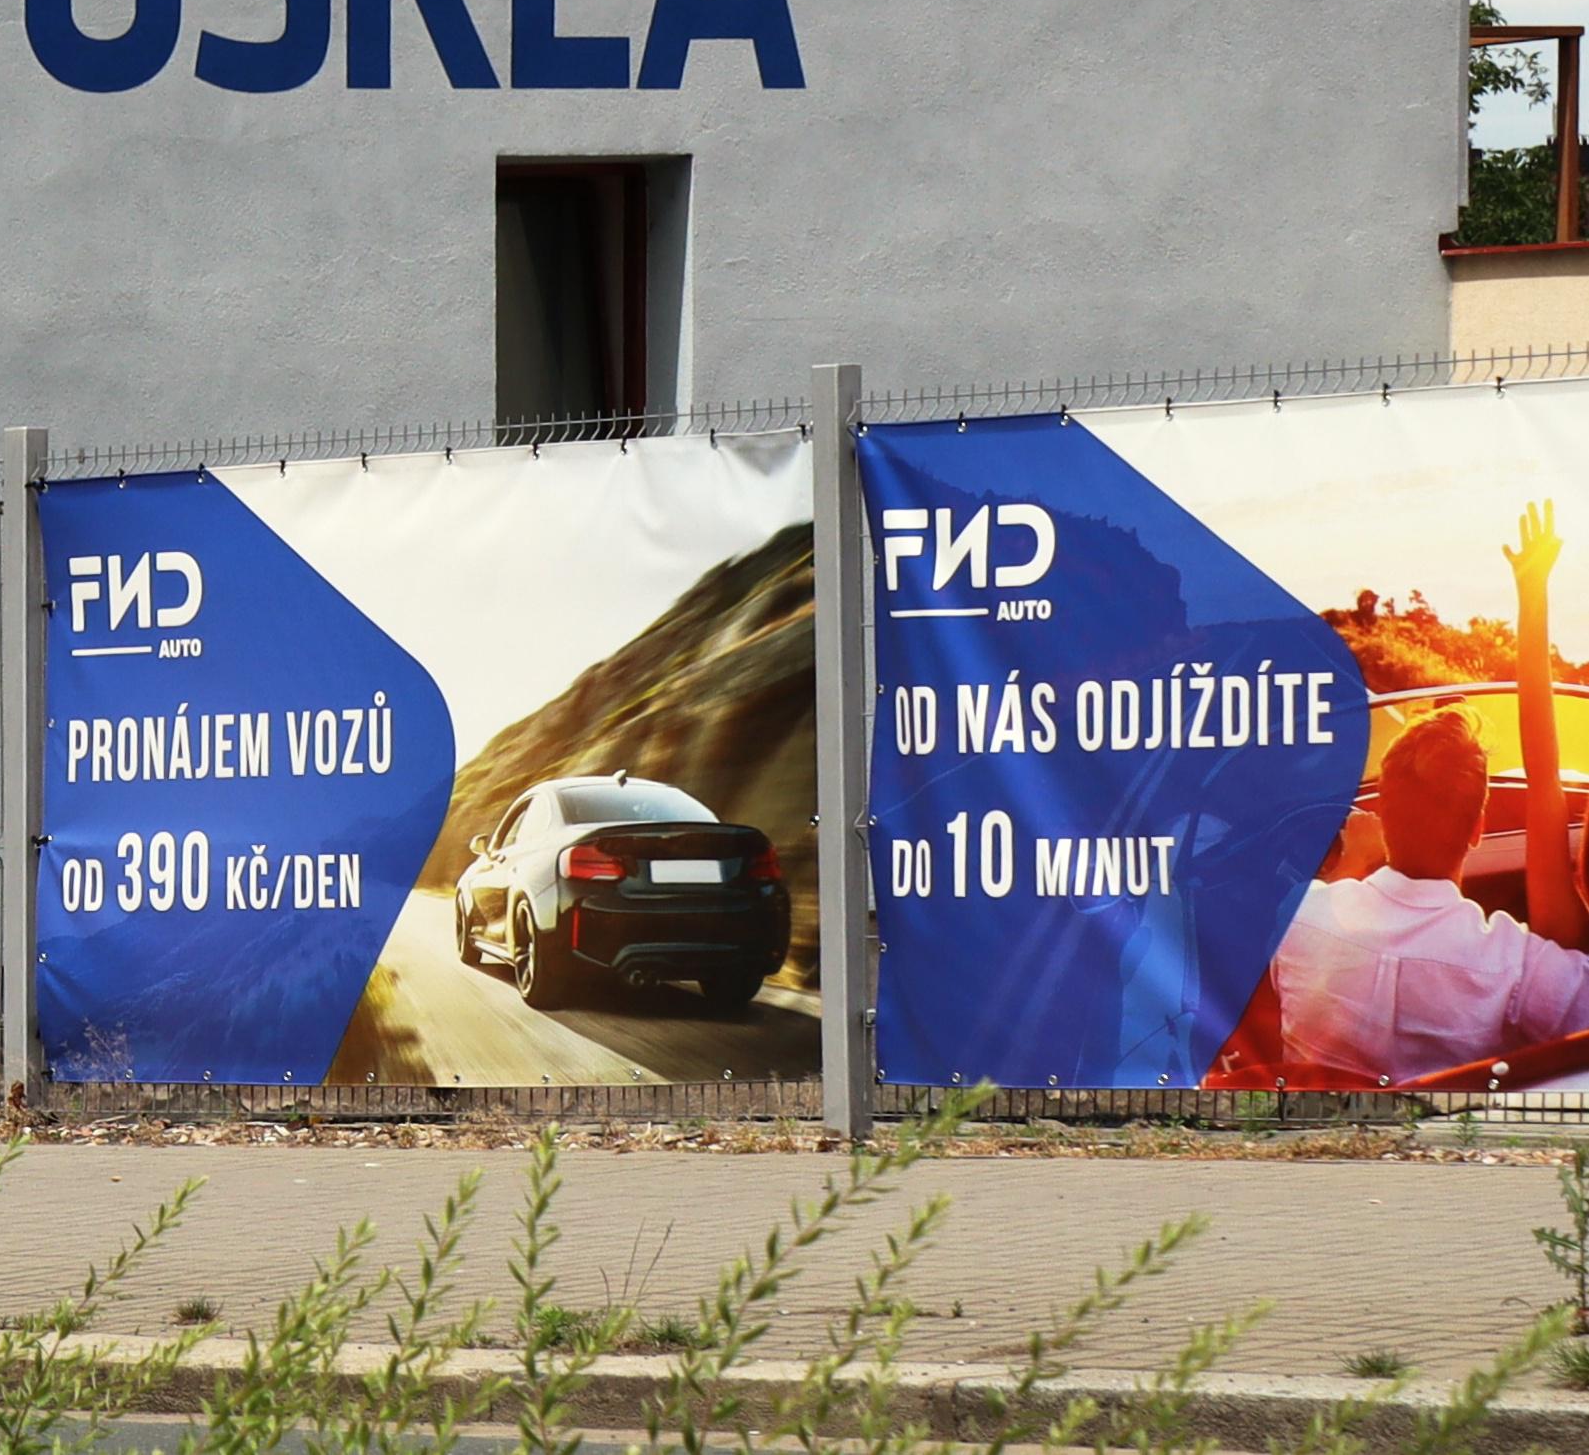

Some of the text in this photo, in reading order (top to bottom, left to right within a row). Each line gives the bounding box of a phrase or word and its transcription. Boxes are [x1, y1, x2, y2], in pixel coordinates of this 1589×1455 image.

[158, 638, 202, 658] AUTO
[996, 599, 1052, 621] AUTO
[68, 690, 392, 783] PRONÁJEM VOZŮ
[895, 659, 1334, 755] OD NÁS ODJÍŽDÍTE
[62, 830, 360, 912] OD 390 KČ/DEN
[892, 810, 1175, 898] DO 10 MINUT
